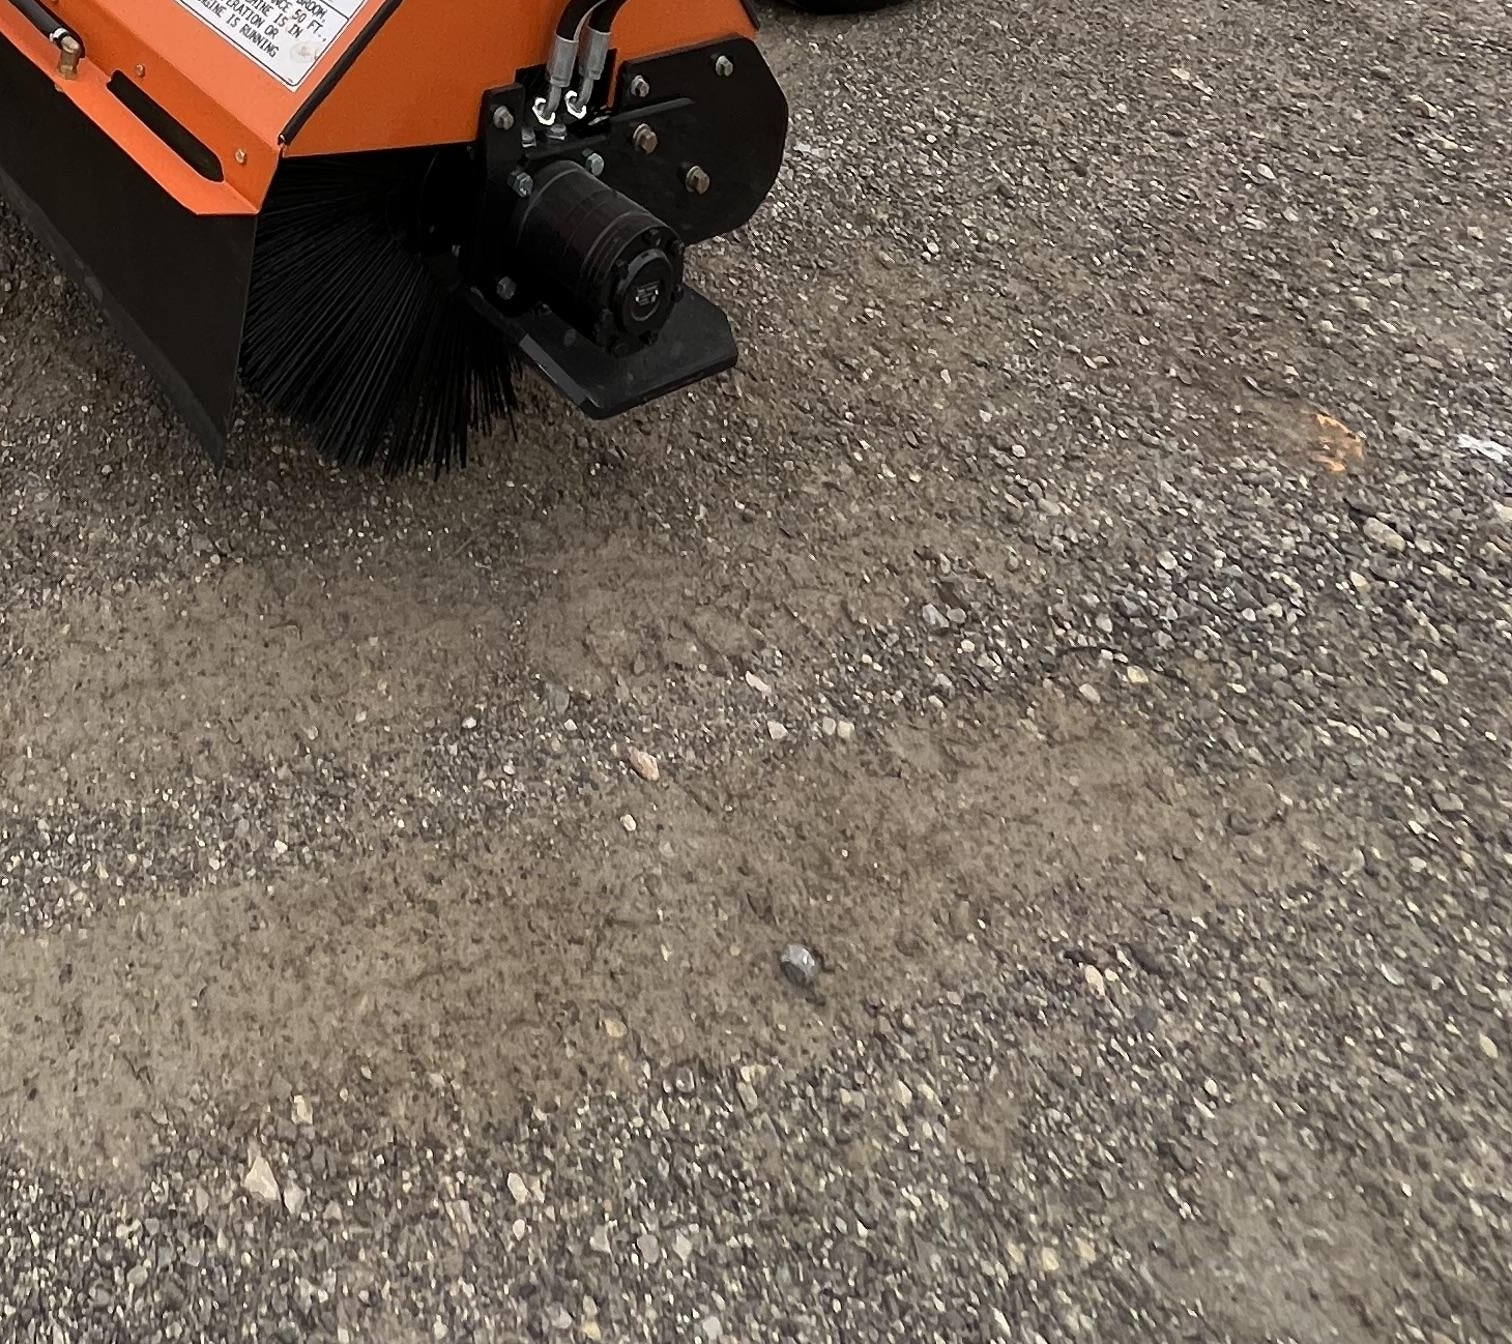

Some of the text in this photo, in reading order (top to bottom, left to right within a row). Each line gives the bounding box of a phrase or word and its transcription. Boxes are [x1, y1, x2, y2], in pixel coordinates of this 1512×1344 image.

[273, 12, 287, 28] IS
[288, 22, 304, 39] IN
[292, 8, 307, 24] 50
[225, 14, 239, 28] IS
[239, 22, 280, 59] RUNNING
[264, 23, 280, 40] OR
